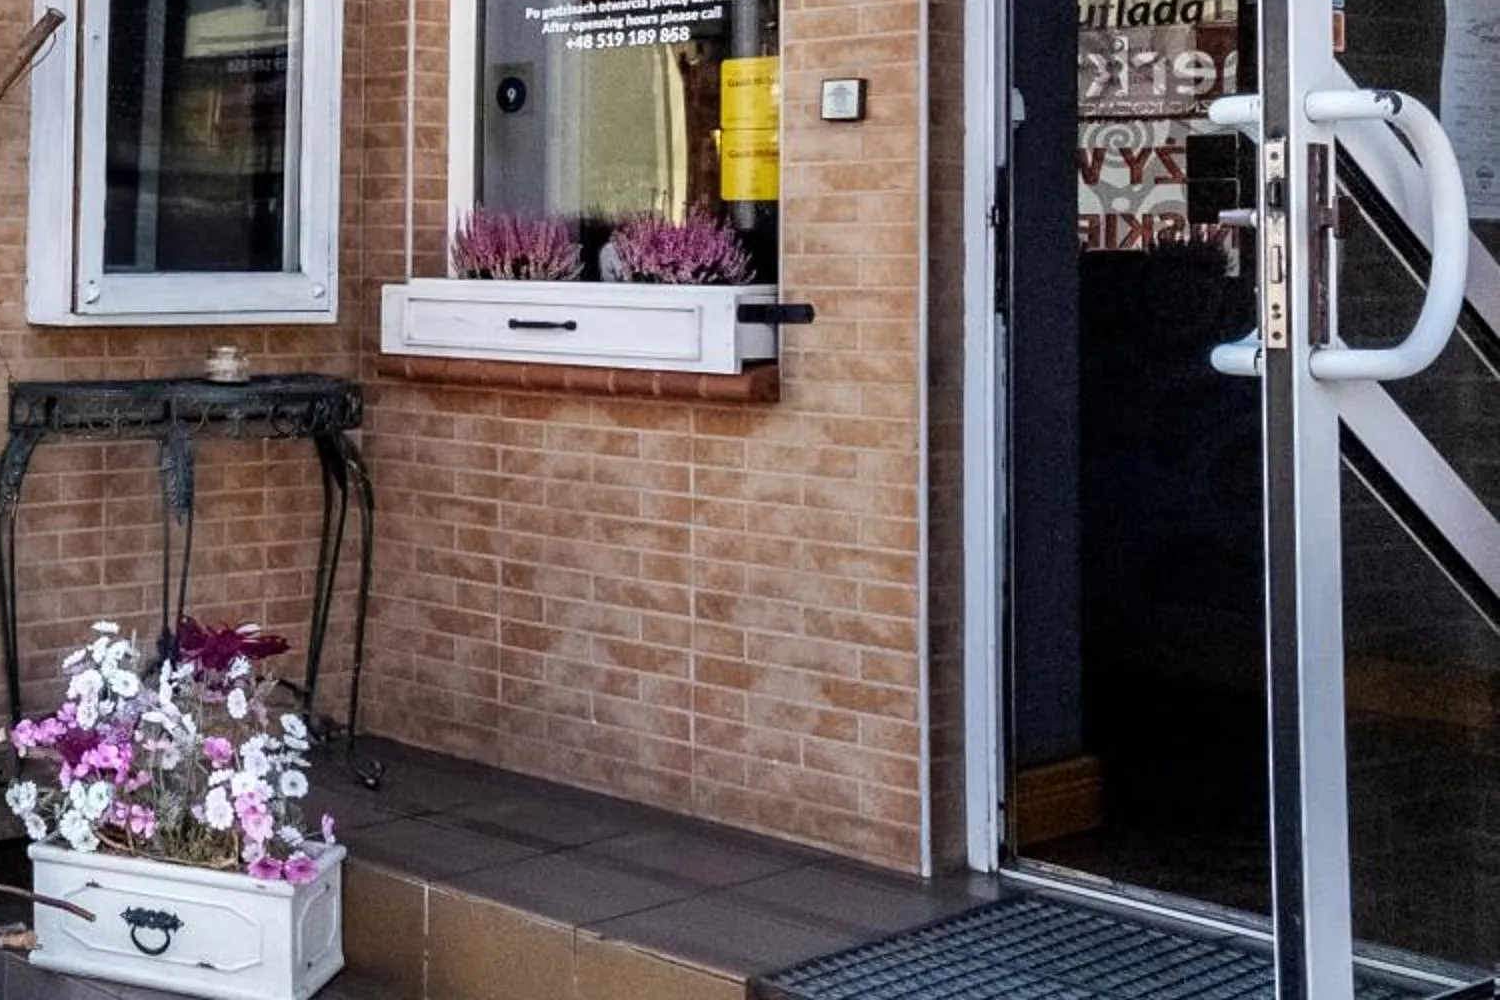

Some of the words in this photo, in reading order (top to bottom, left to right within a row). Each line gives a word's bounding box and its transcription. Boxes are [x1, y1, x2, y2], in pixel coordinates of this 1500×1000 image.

[541, 21, 570, 35] After
[625, 13, 658, 28] hours
[660, 10, 699, 25] please
[701, 5, 723, 20] call
[565, 34, 594, 50] +48
[596, 31, 625, 49] 519
[627, 29, 657, 46] 189
[659, 26, 691, 43] 858
